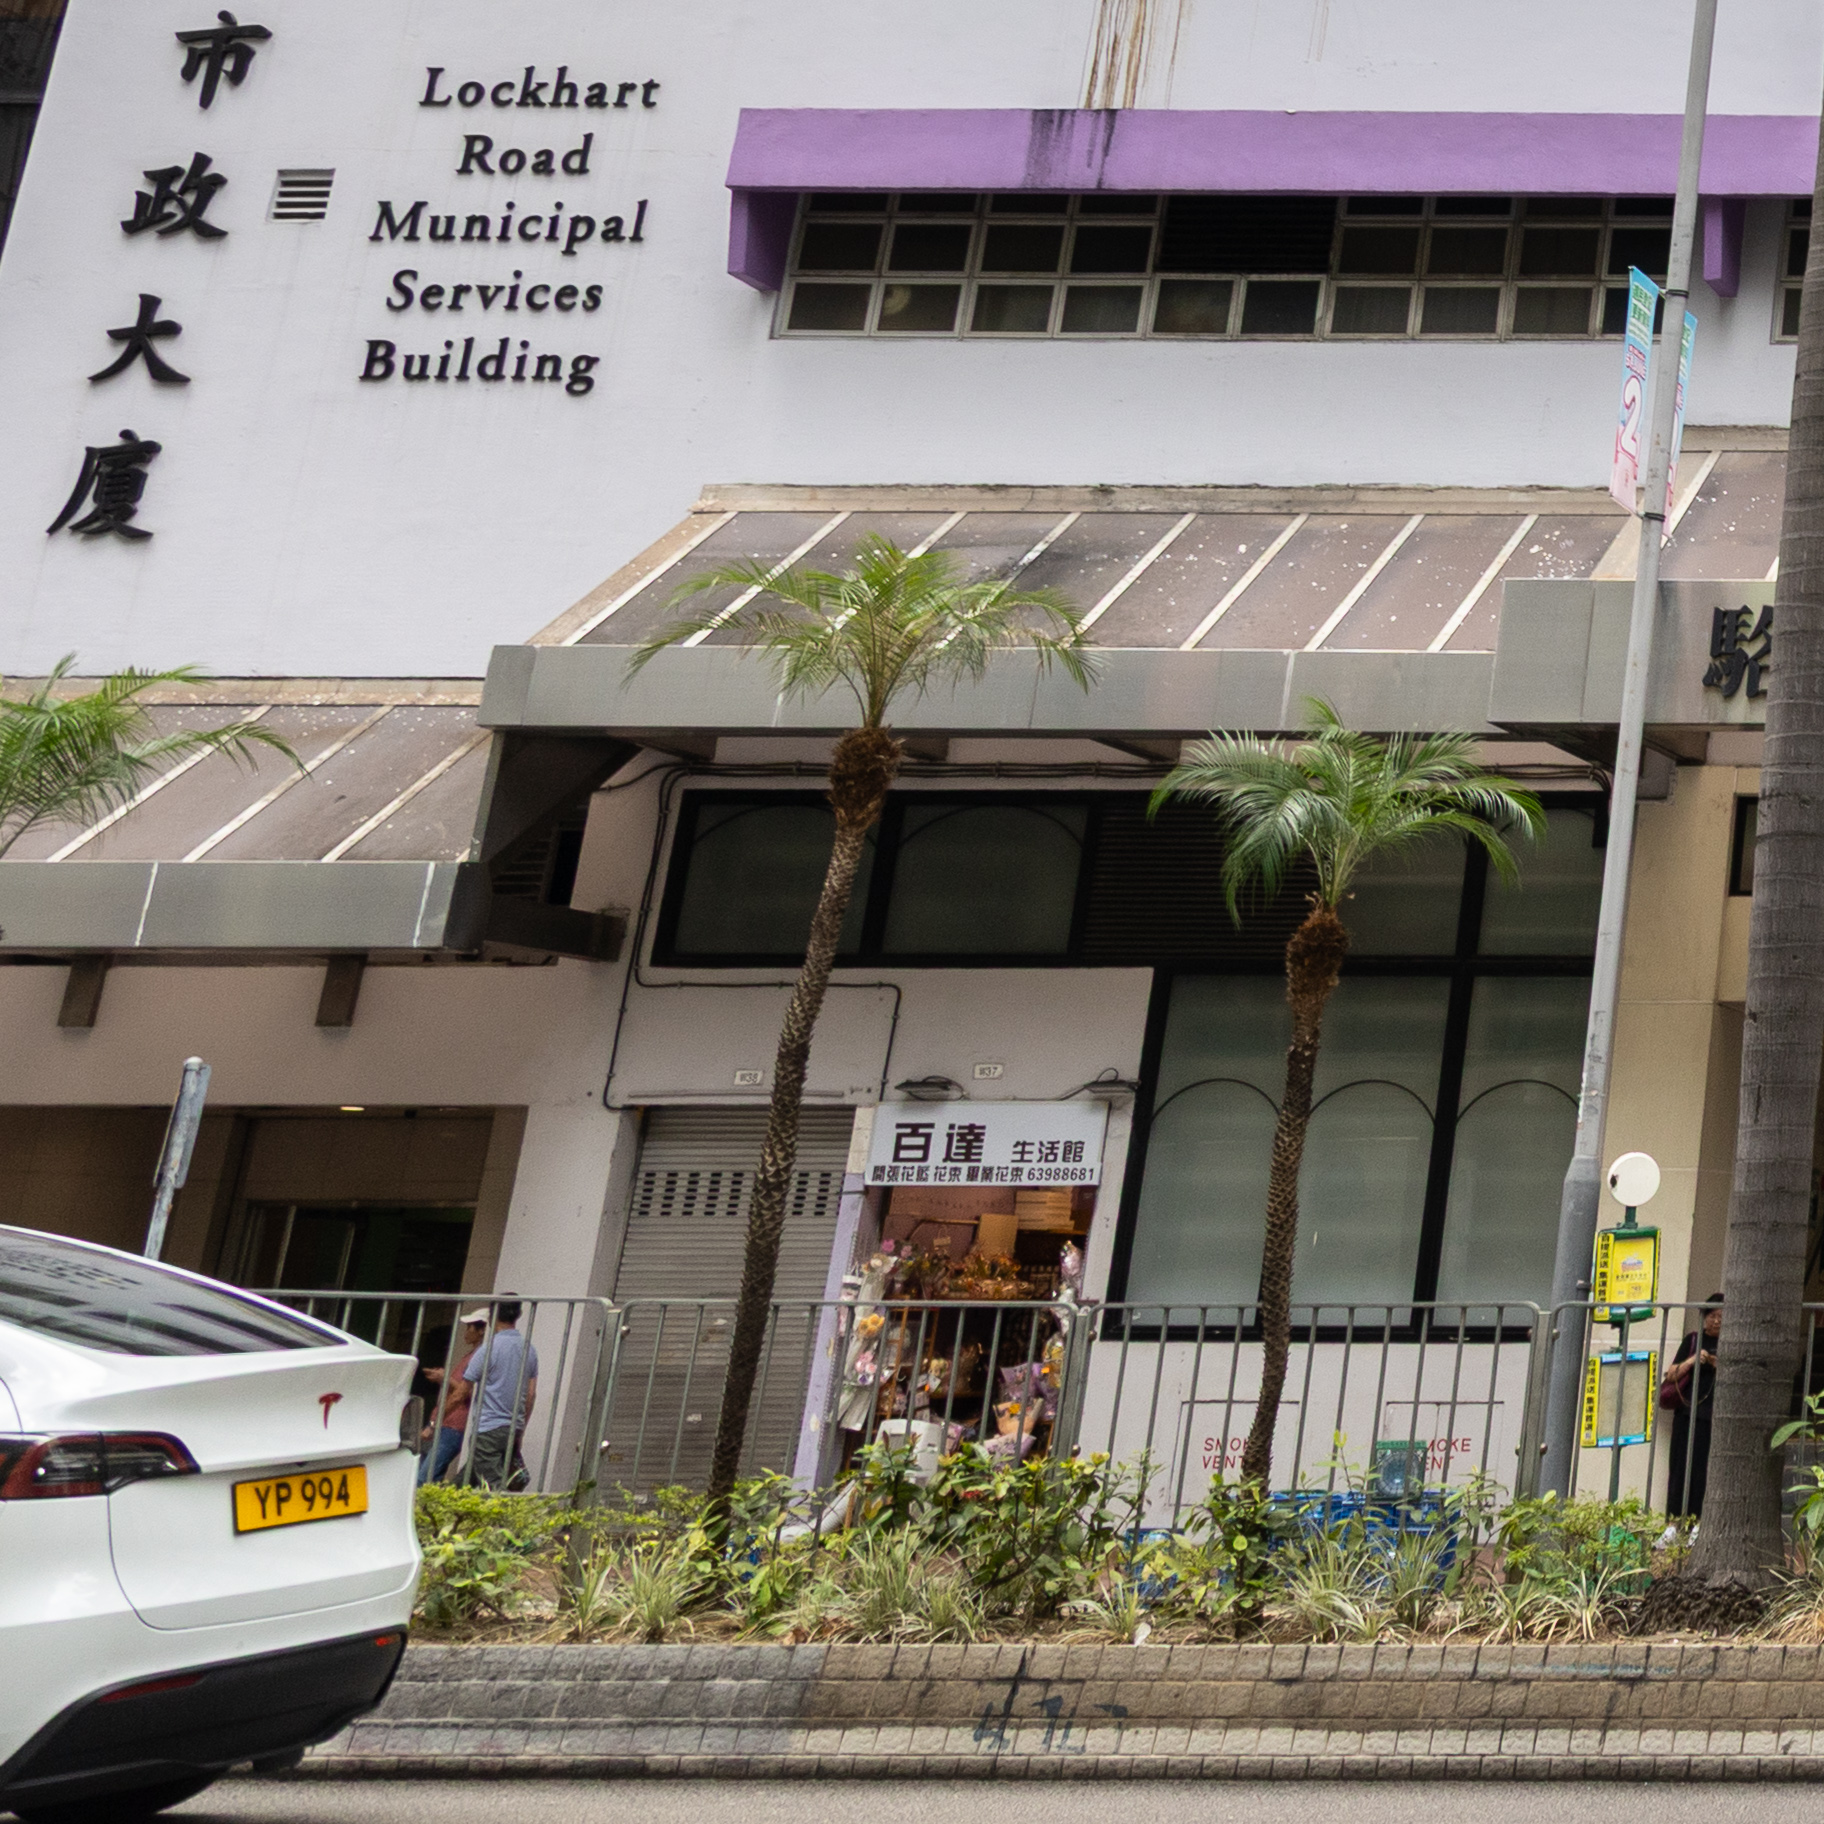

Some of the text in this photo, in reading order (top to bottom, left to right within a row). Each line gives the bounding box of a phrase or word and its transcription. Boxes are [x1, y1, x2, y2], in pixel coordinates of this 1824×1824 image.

[419, 66, 661, 109] Lockhart
[455, 133, 594, 177] Road
[369, 199, 649, 255] Municipal
[386, 268, 603, 313] Services
[359, 338, 600, 395] Building
[892, 1122, 1086, 1164] 百達 生活館
[1027, 1167, 1094, 1181] 63988681
[254, 1474, 350, 1519] YP 994
